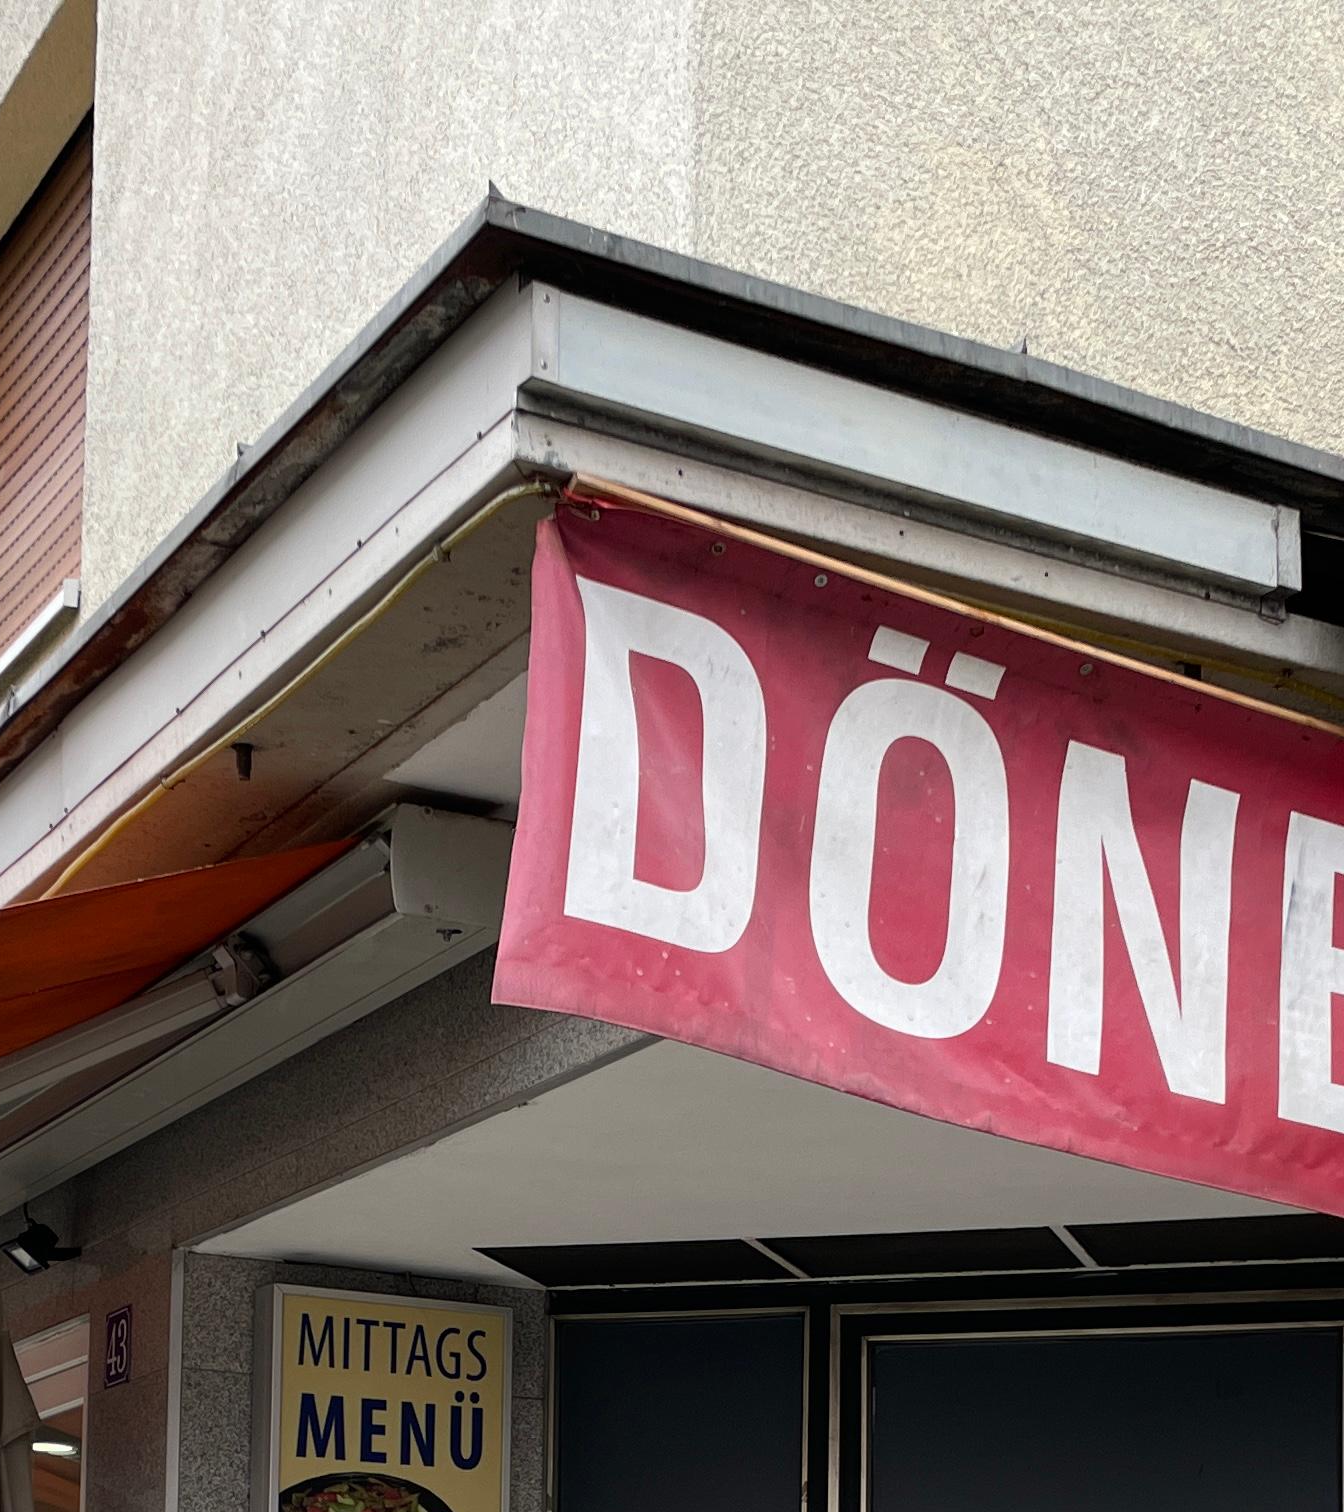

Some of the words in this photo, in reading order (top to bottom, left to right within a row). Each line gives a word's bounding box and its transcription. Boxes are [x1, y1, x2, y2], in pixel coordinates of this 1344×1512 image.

[107, 1319, 127, 1376] 43
[298, 1313, 487, 1381] MITTAGS
[296, 1391, 484, 1470] MENÜ
